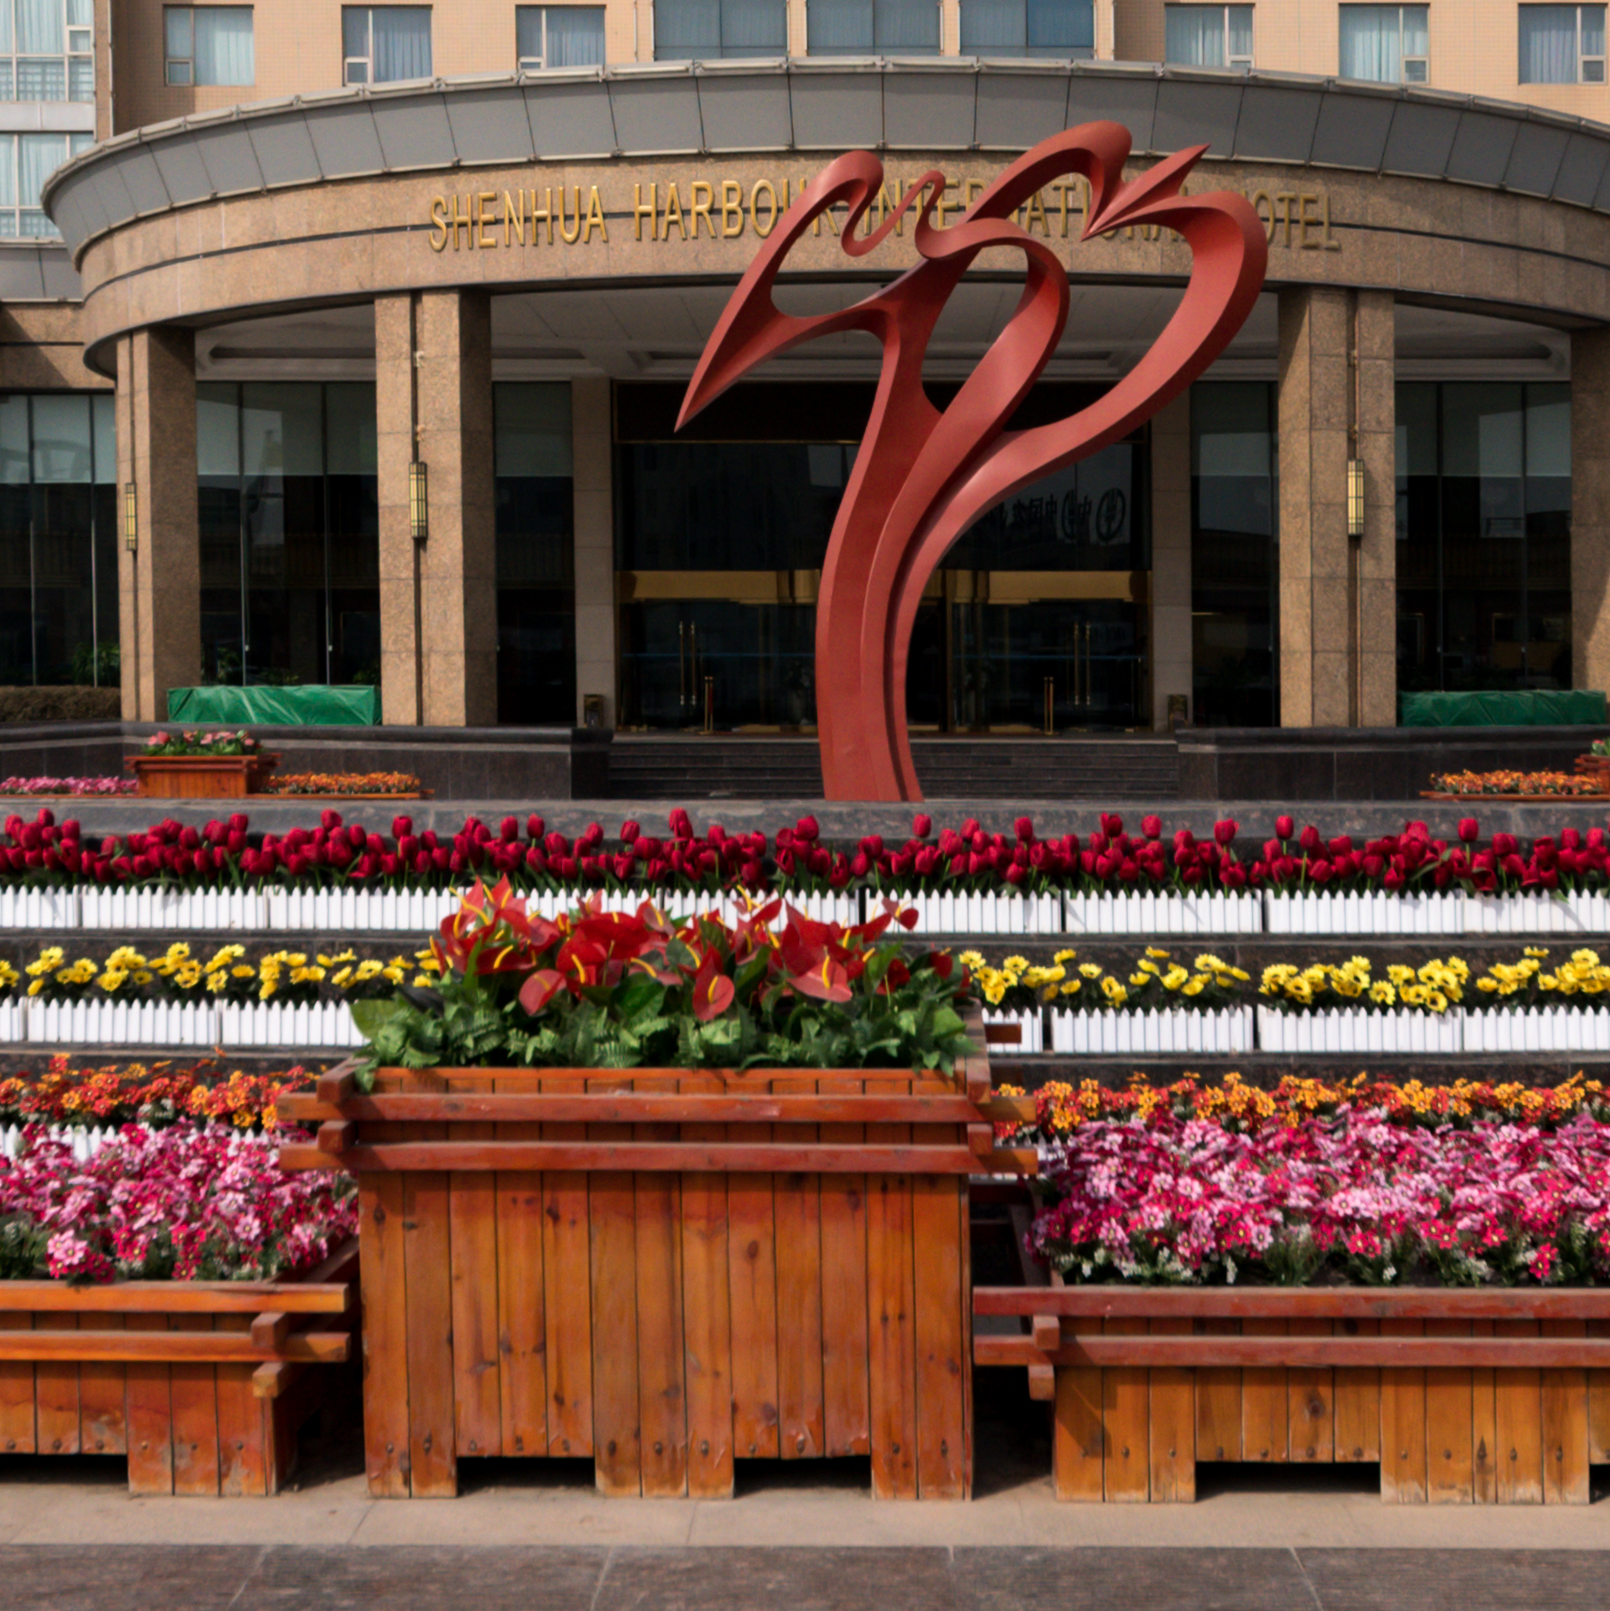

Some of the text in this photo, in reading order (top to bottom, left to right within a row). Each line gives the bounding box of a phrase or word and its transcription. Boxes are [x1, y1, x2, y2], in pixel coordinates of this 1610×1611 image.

[429, 185, 608, 253] SHENHUA
[863, 177, 1197, 241] INTEATI
[1230, 188, 1341, 252] OTEL
